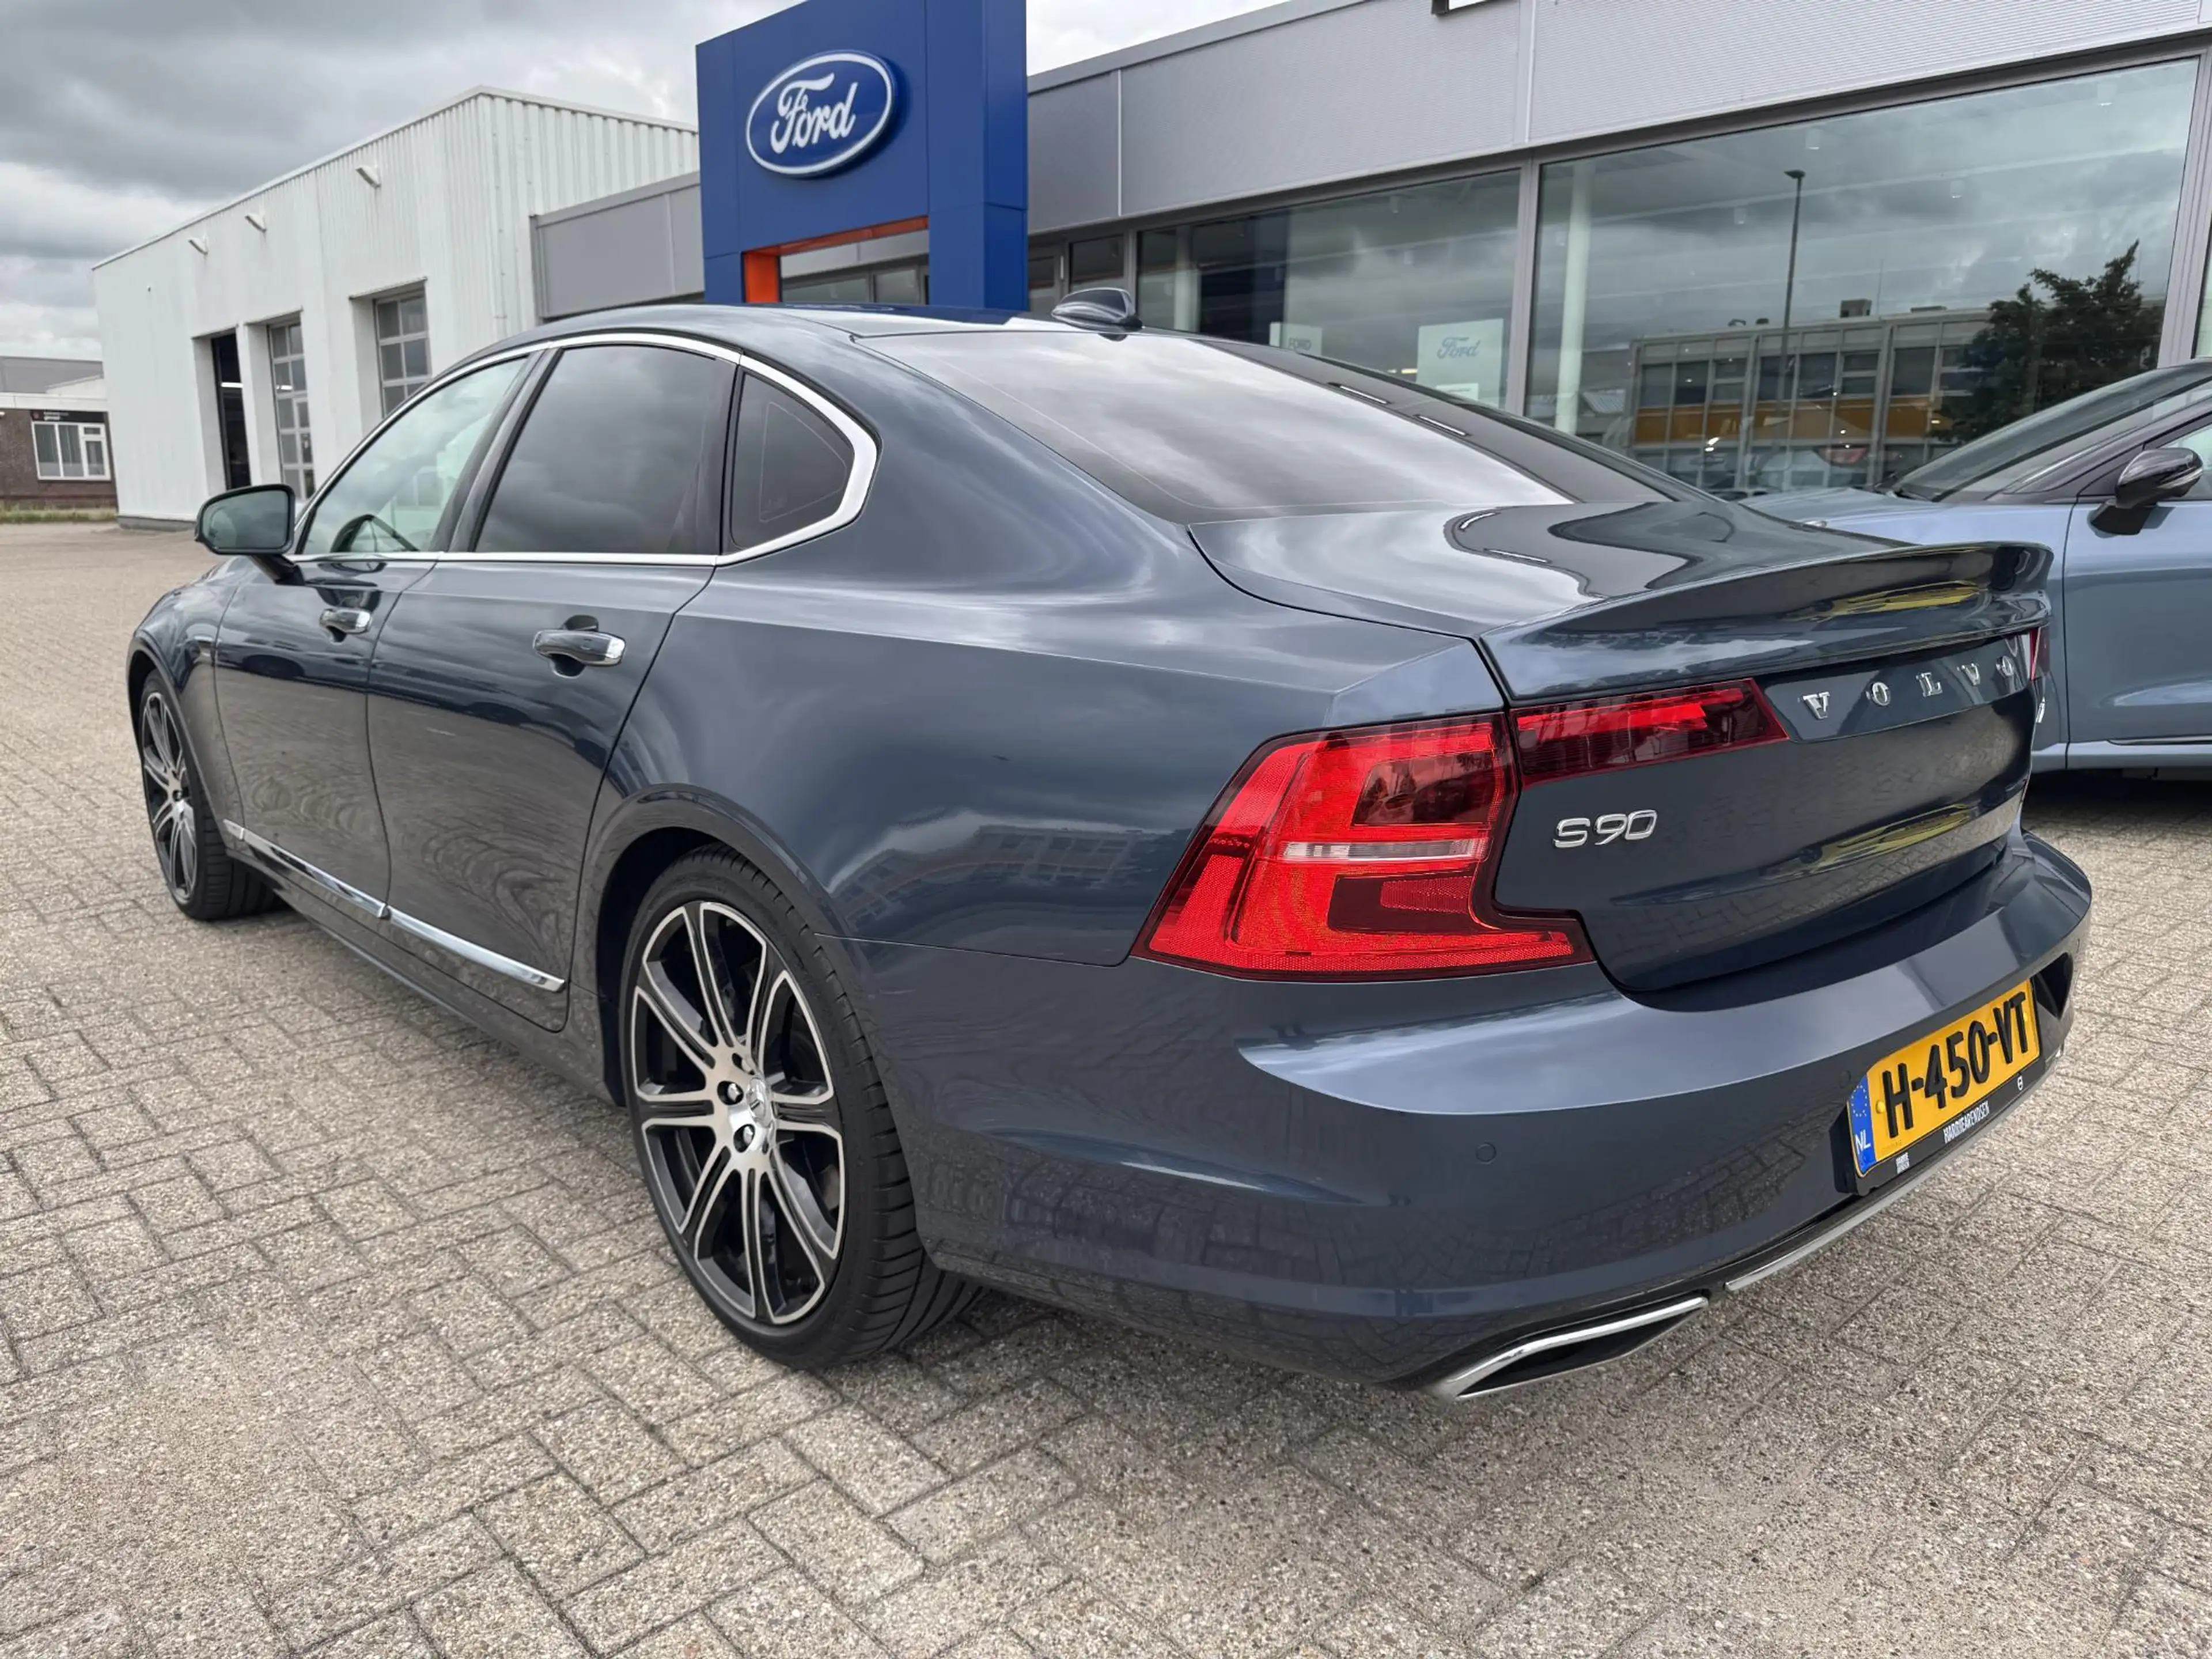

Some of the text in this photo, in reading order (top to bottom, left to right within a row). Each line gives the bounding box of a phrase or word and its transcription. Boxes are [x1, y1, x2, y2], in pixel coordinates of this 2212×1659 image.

[770, 73, 858, 154] Ford
[1437, 336, 1480, 359] Ford
[1798, 655, 2014, 719] VOLVO
[1552, 809, 1657, 848] S90
[1882, 991, 2028, 1139] H-450-VT
[1855, 1129, 1871, 1155] NL
